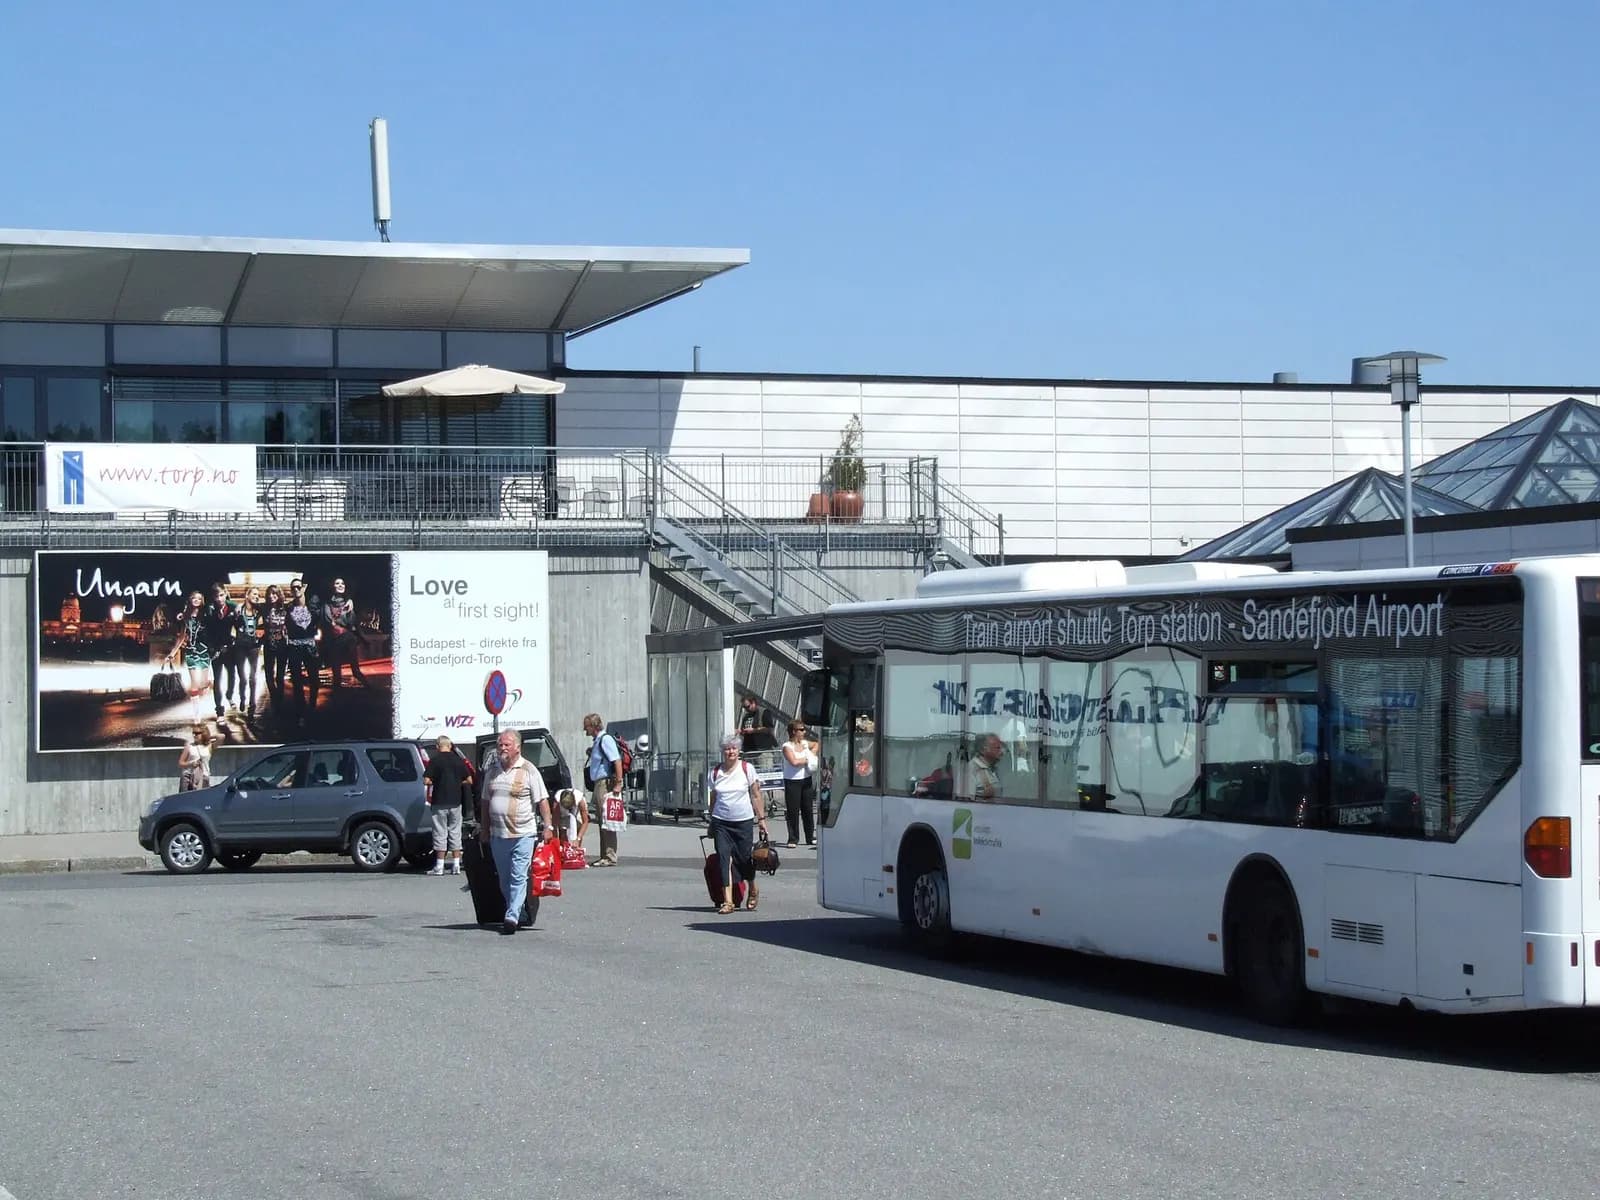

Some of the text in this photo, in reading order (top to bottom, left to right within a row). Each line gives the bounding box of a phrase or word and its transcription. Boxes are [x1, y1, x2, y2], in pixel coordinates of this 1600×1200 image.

[99, 466, 240, 496] www.torp.no
[76, 567, 183, 614] Ungarn
[410, 575, 468, 596] Love
[443, 596, 539, 622] at first sight!
[964, 612, 999, 648] Train
[1003, 611, 1053, 656] airport
[1057, 608, 1112, 647] shuttle
[1117, 606, 1155, 652] Torp
[1160, 602, 1222, 644] station
[1242, 596, 1358, 650] Sandefjord
[1362, 592, 1443, 649] Airport
[410, 637, 466, 652] Budapest
[480, 637, 519, 649] direkte
[522, 636, 537, 649] fra
[410, 653, 503, 667] Sandefjord-Torp
